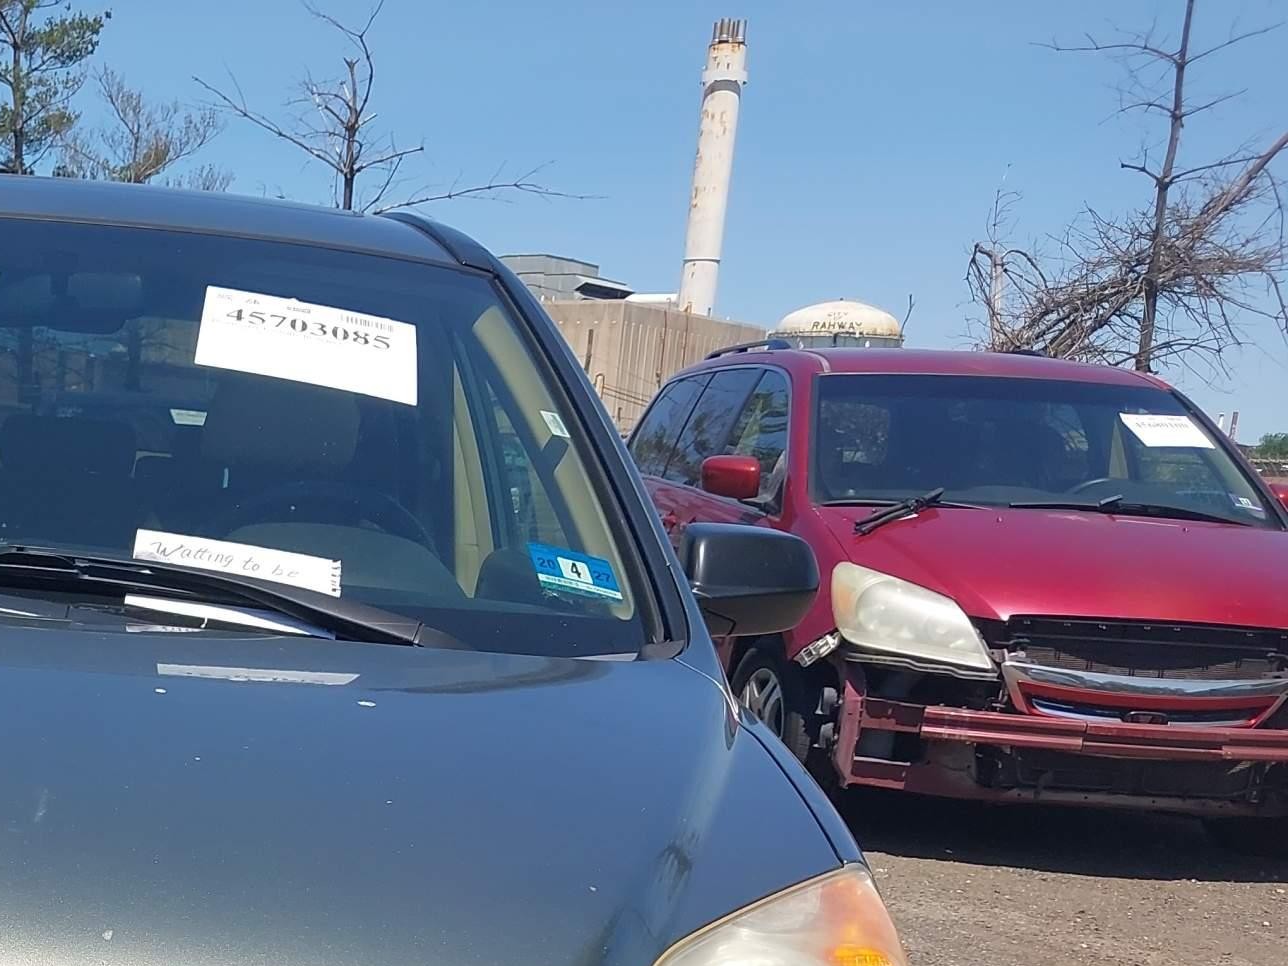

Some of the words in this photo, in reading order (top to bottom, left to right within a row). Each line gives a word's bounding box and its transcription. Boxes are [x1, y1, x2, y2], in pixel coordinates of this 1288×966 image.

[225, 307, 392, 351] 45703085
[811, 321, 863, 330] RAHWAY
[241, 556, 261, 572] to
[271, 563, 300, 578] be
[536, 557, 556, 570] 20
[570, 562, 582, 579] 4
[592, 570, 611, 583] 27
